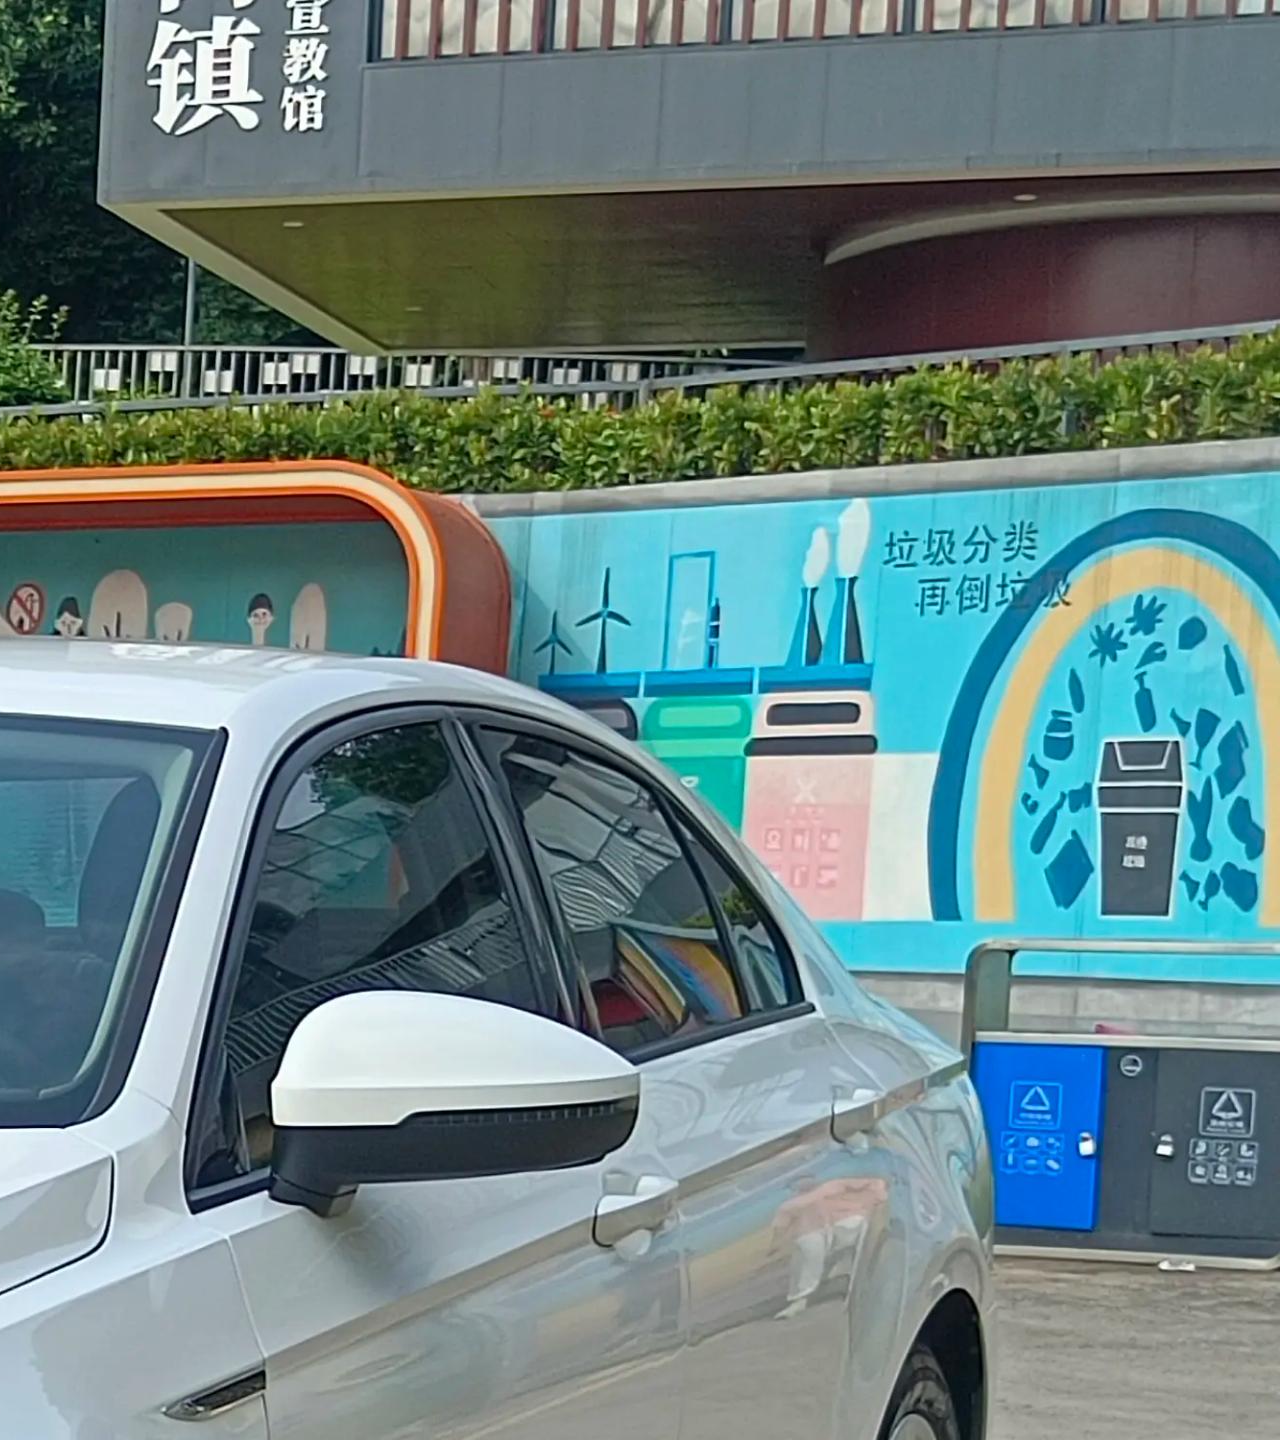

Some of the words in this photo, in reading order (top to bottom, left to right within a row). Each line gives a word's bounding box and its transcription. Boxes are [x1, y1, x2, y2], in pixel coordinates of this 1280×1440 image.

[146, 0, 265, 136] 镇
[280, 0, 329, 132] 宣教馆
[882, 519, 1039, 568] 垃圾分类
